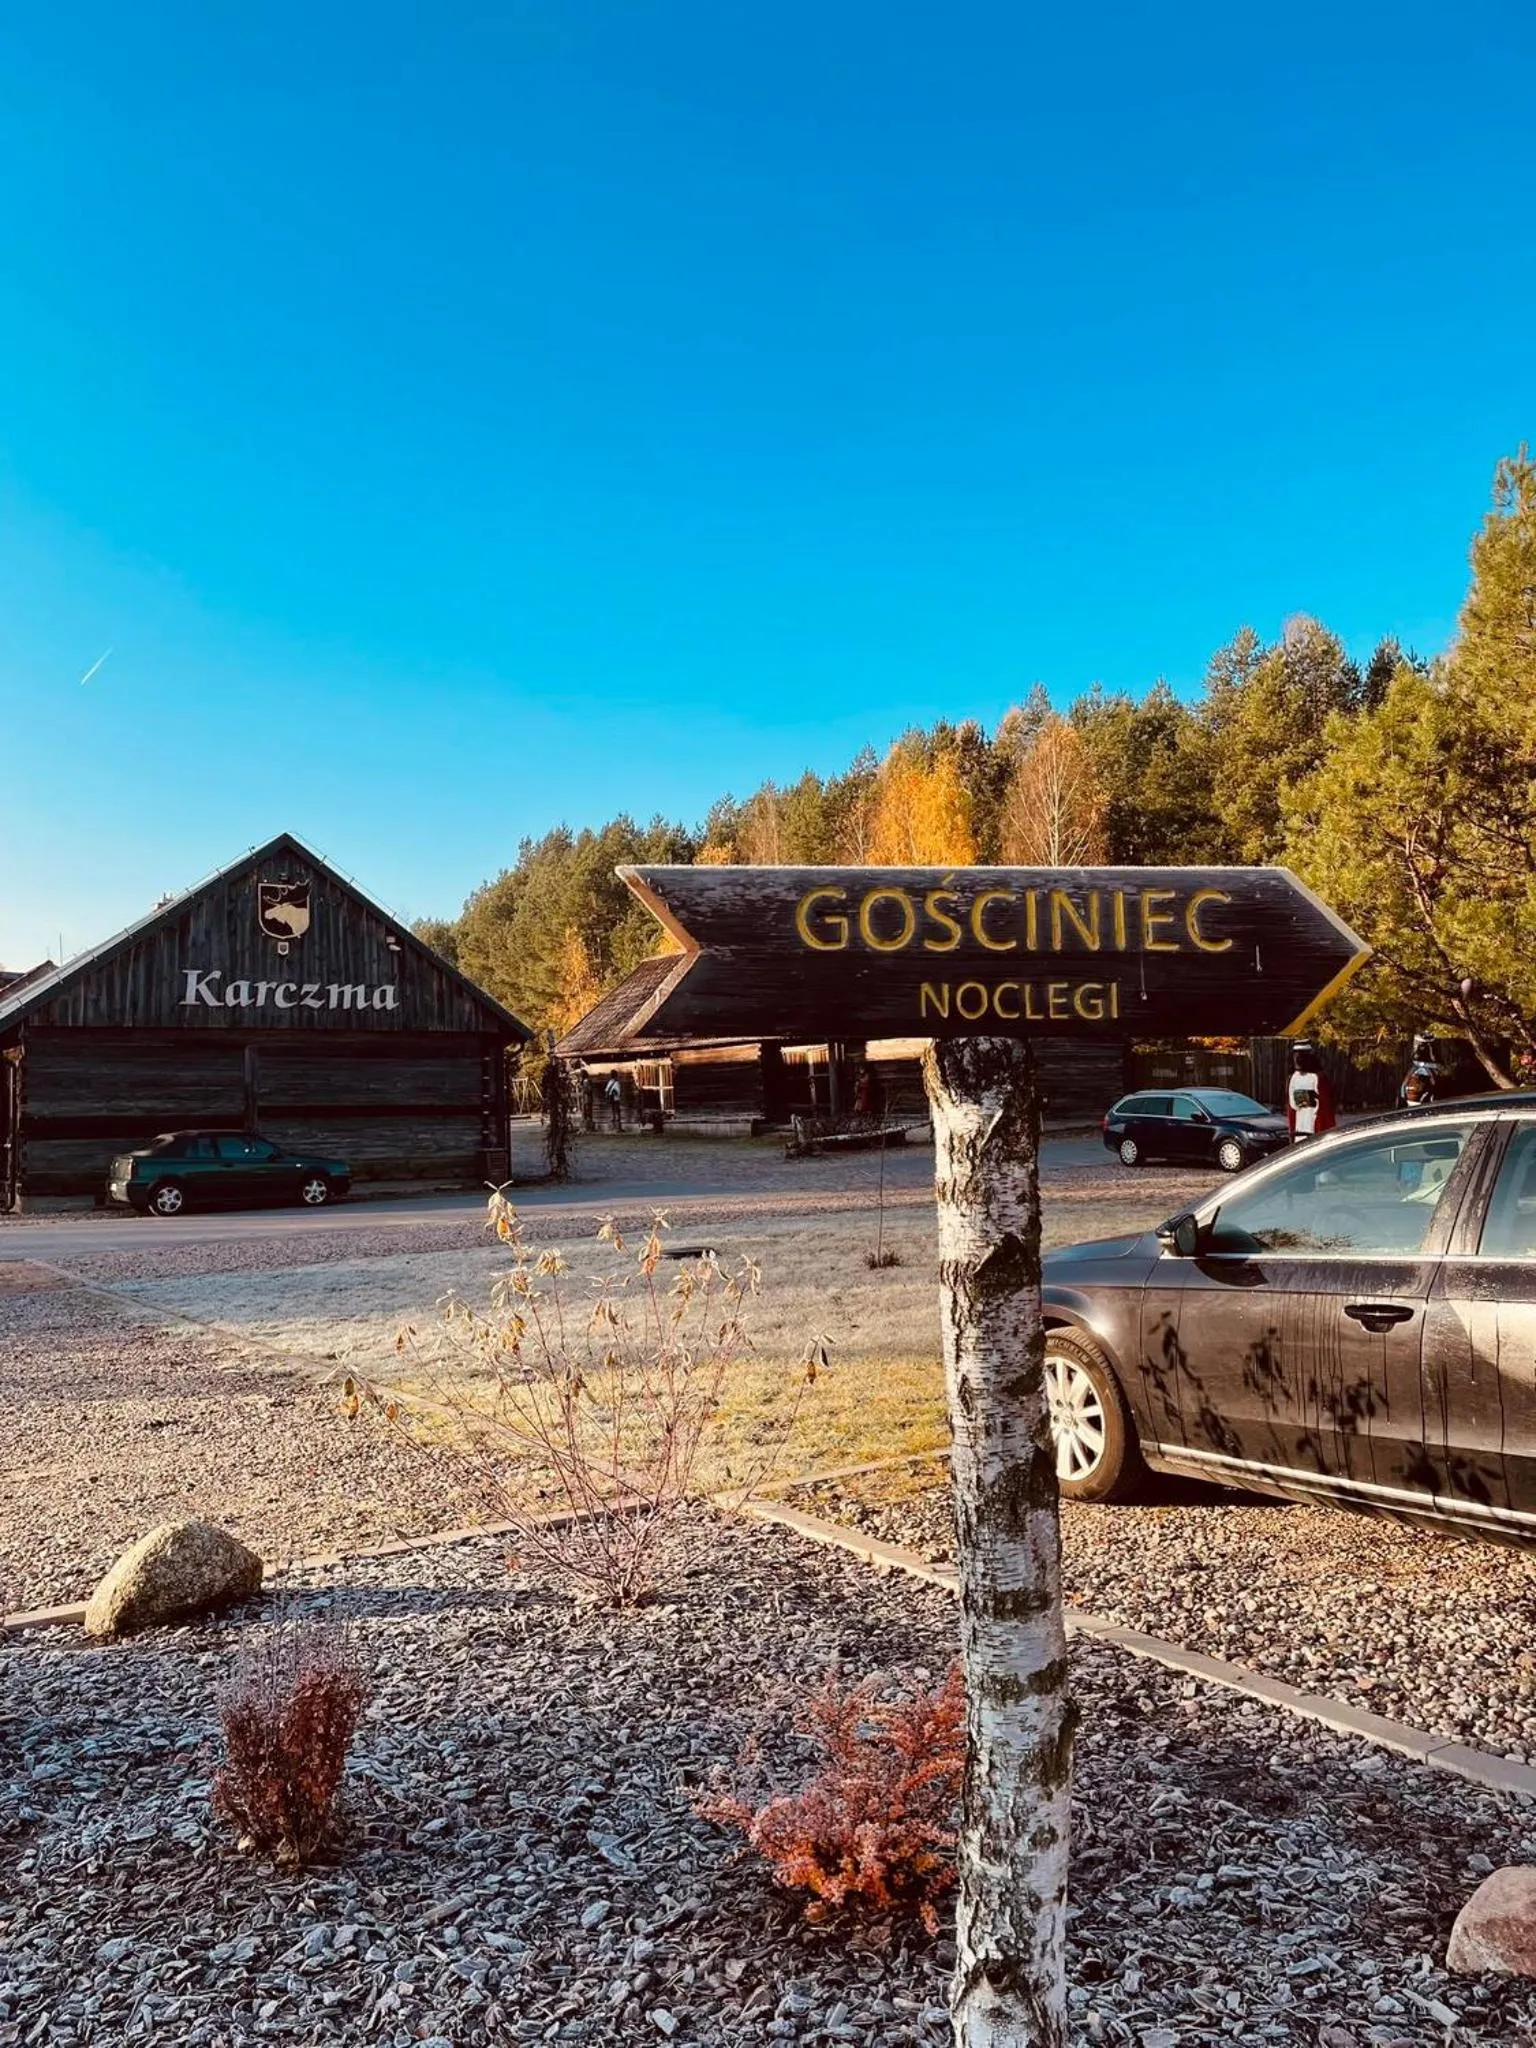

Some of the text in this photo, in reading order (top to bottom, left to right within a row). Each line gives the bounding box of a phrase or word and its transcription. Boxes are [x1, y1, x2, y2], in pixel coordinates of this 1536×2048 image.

[796, 873, 1233, 952] GOŚCINIEC
[180, 968, 400, 1011] Karczma
[919, 982, 1119, 1020] NOCLEGI
